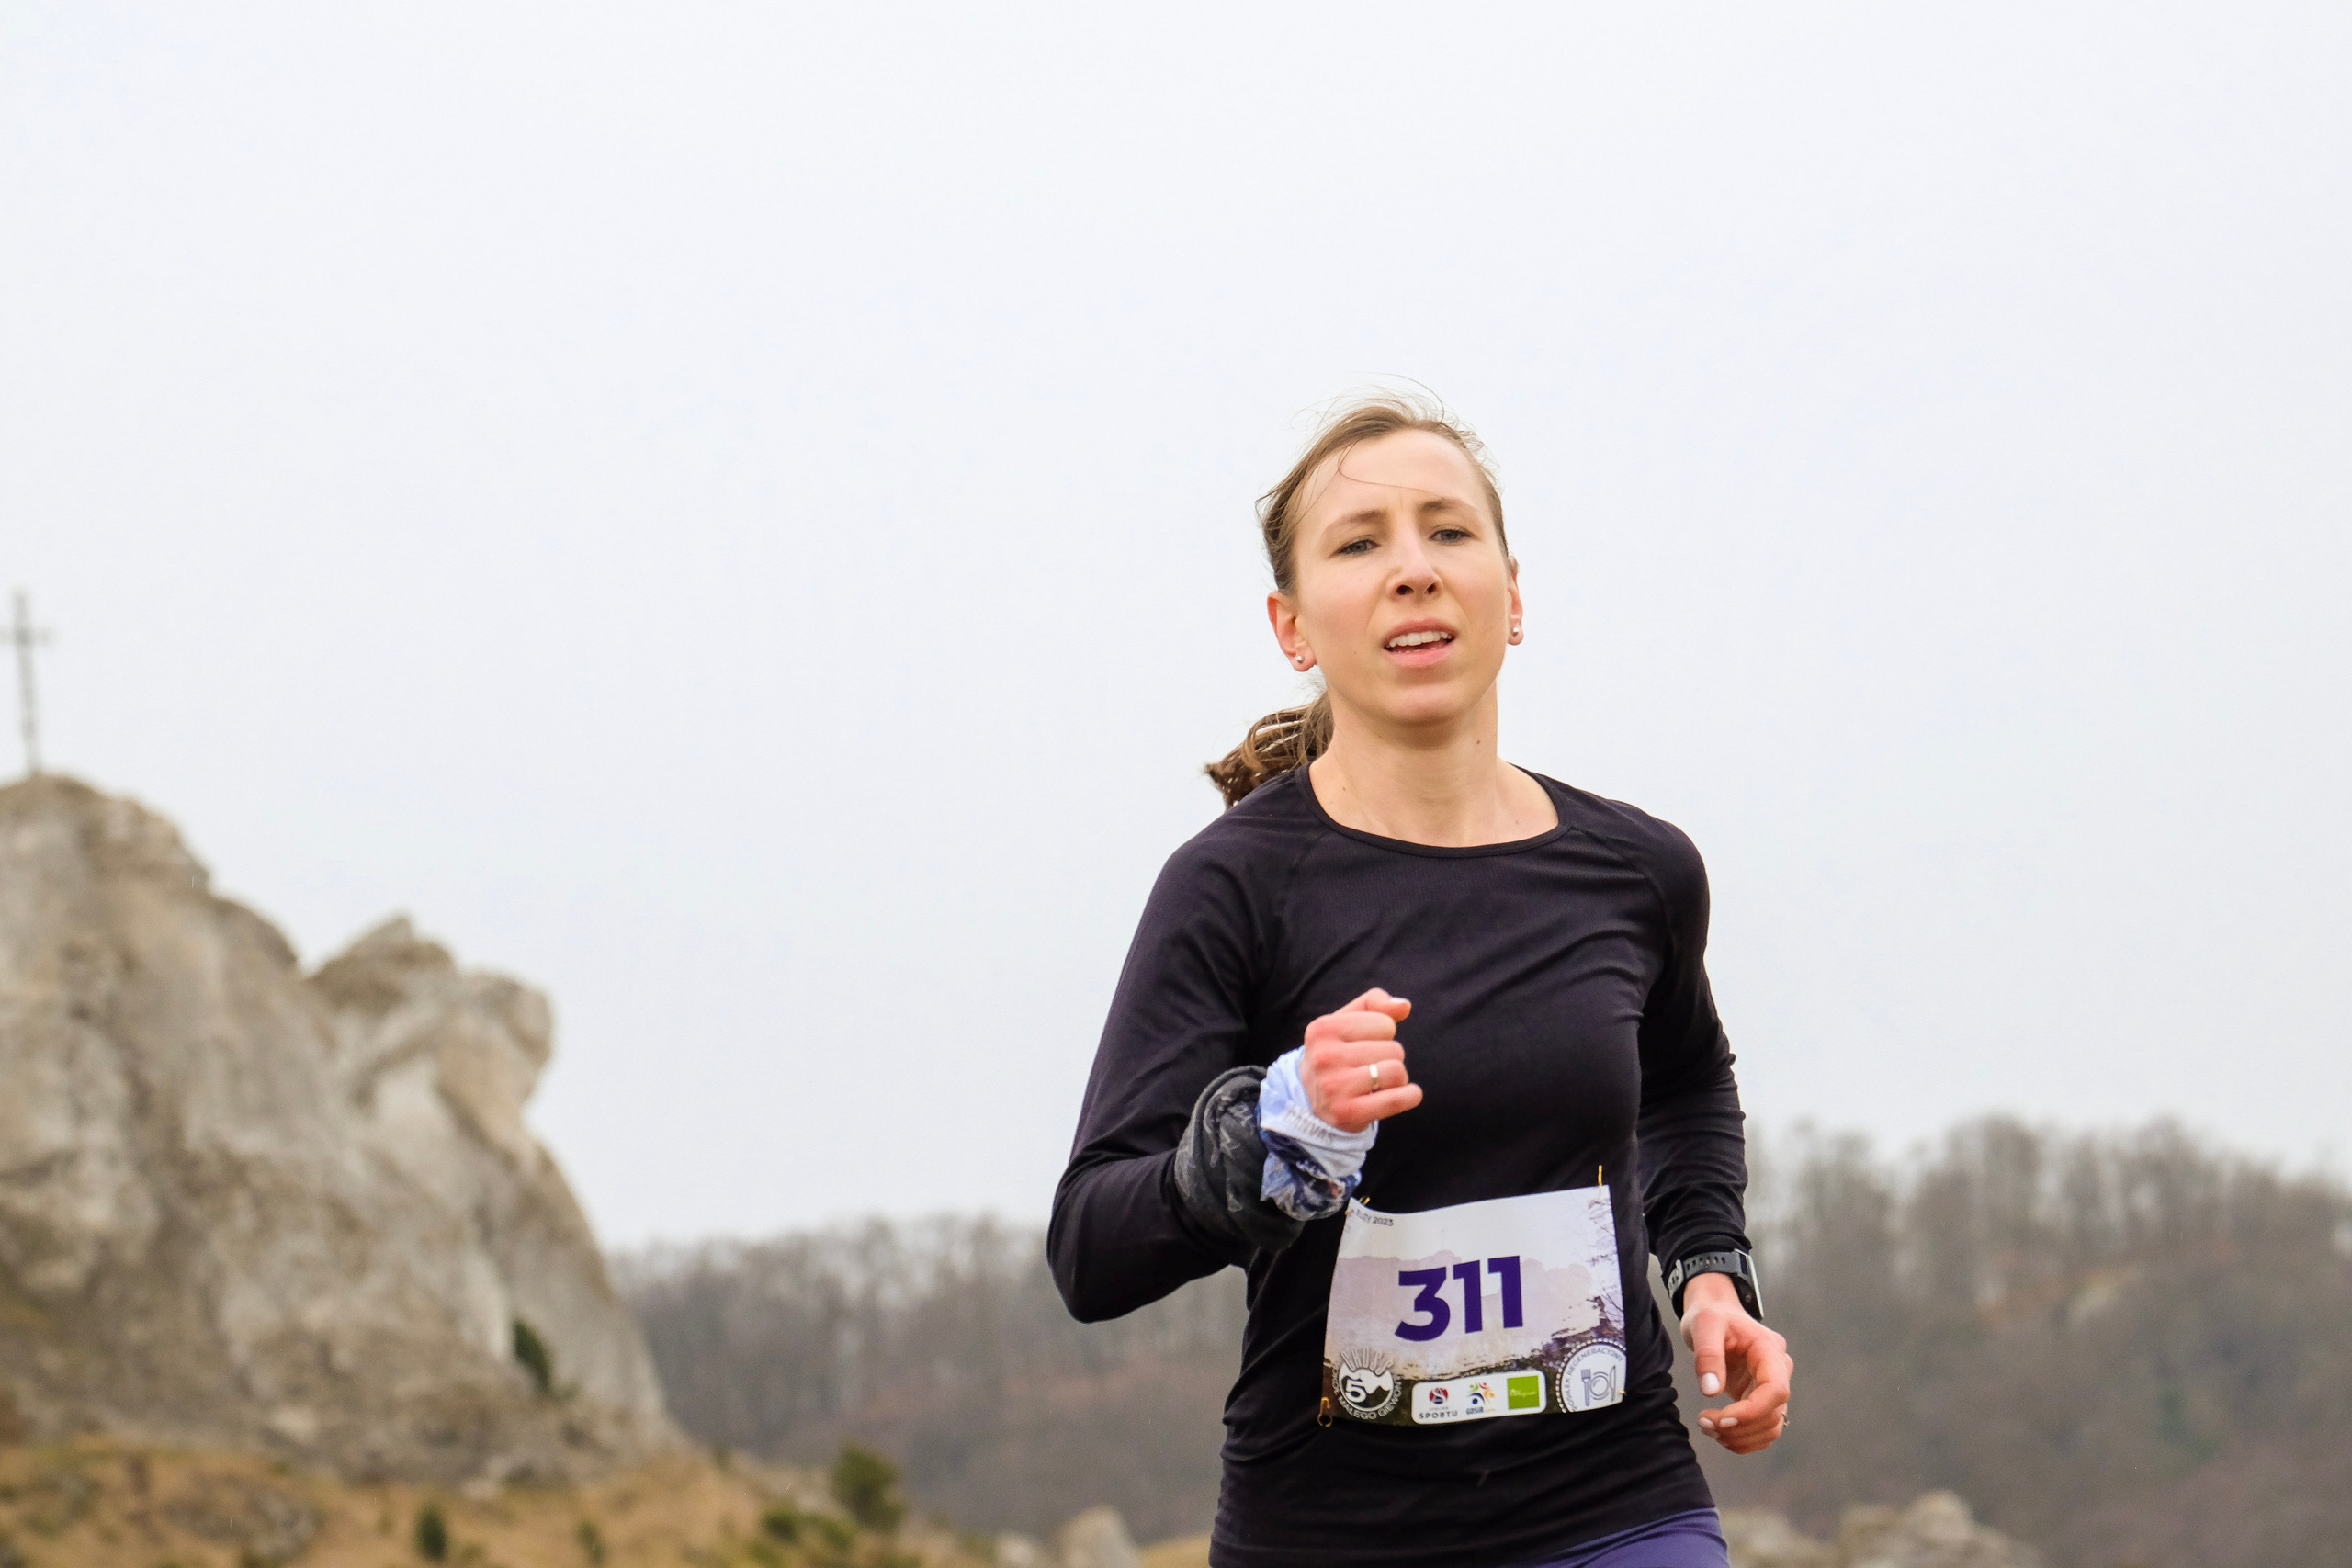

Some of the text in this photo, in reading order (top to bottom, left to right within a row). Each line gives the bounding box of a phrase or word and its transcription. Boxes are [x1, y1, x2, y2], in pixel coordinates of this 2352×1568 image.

[1373, 1216, 1395, 1227] 2023
[1394, 1255, 1524, 1342] 311
[1340, 1347, 1394, 1377] CROSS
[1343, 1378, 1367, 1403] 5
[1419, 1410, 1458, 1419] SPORTU
